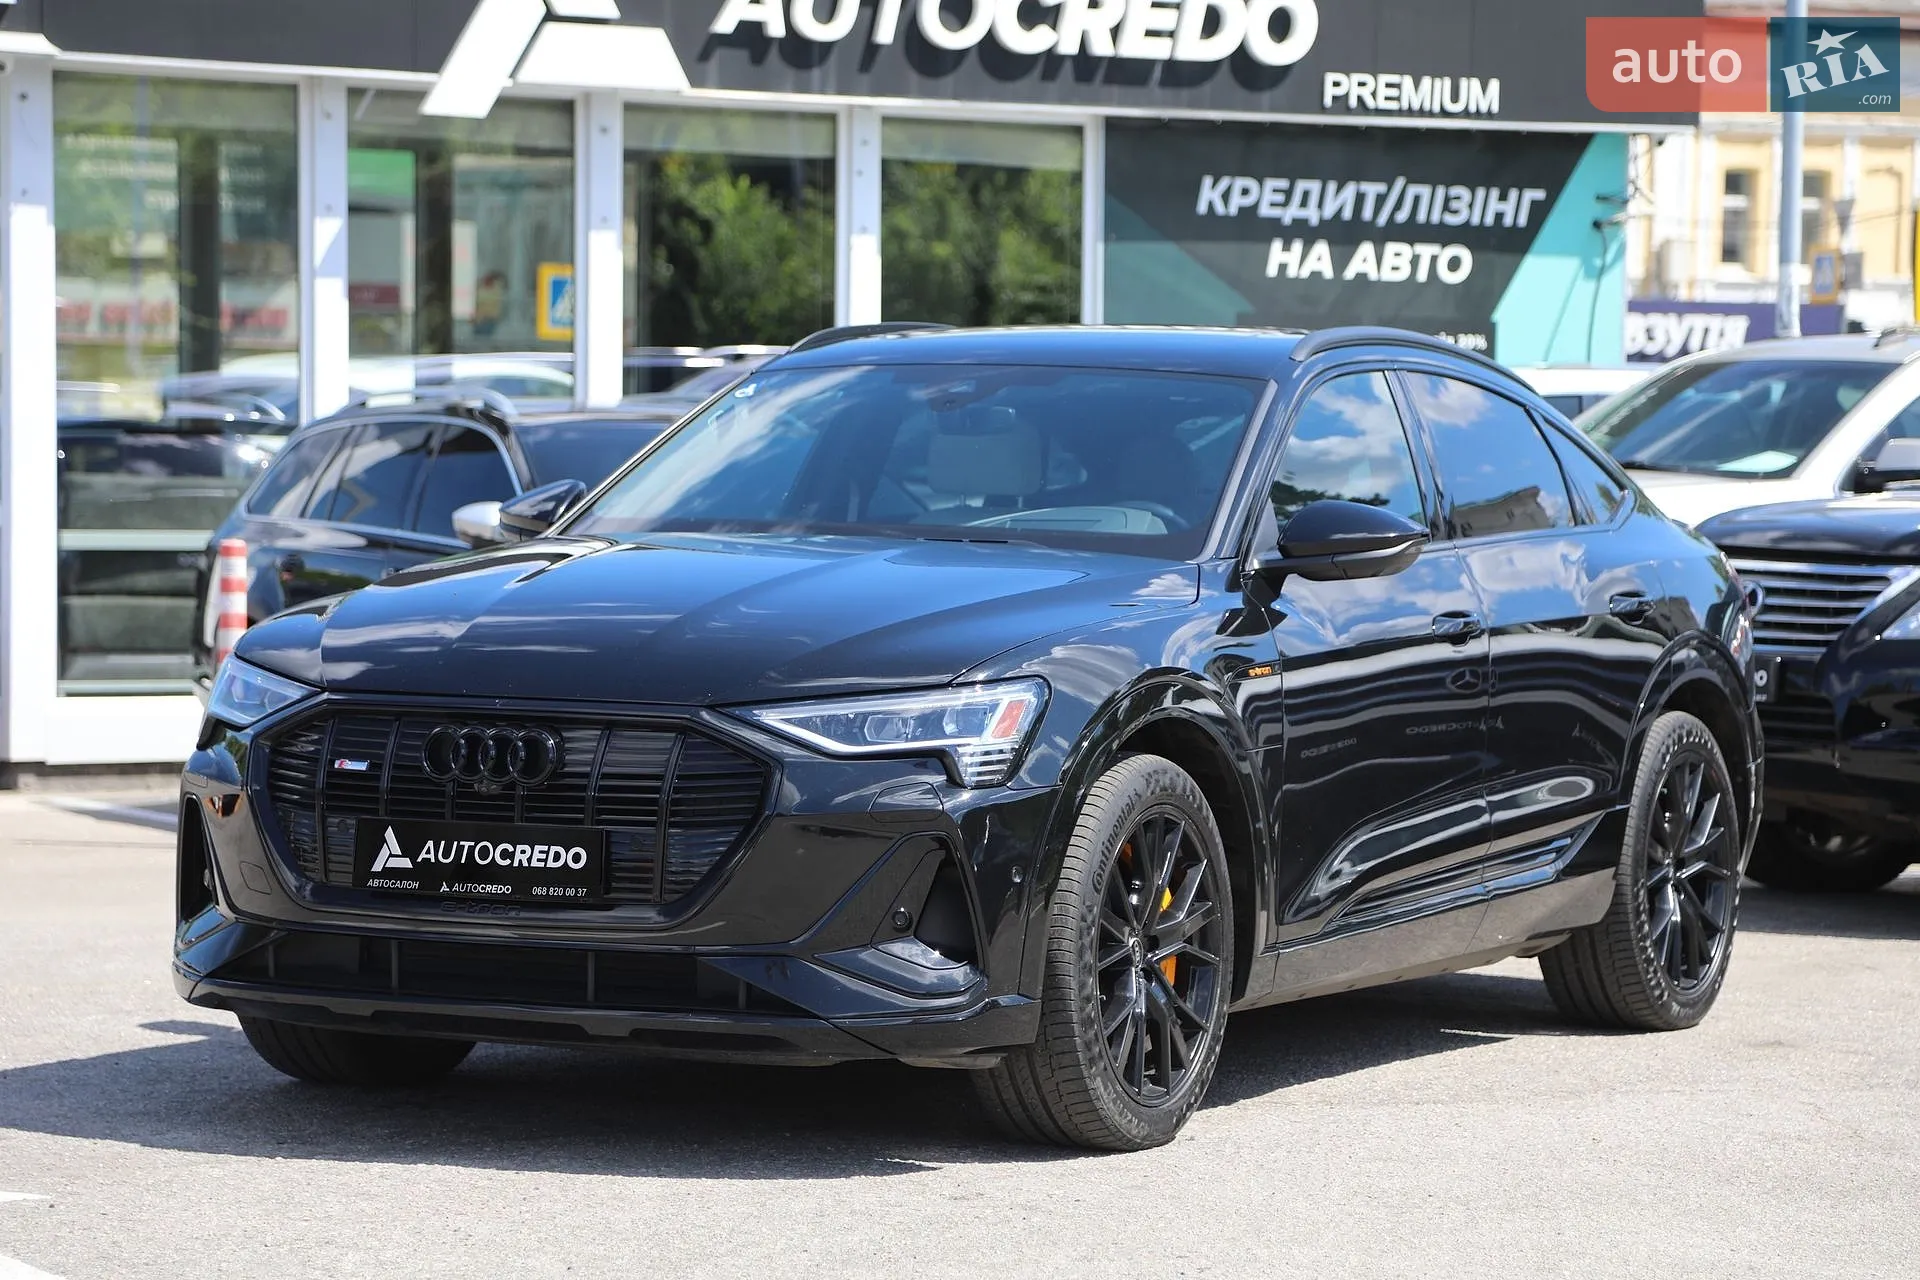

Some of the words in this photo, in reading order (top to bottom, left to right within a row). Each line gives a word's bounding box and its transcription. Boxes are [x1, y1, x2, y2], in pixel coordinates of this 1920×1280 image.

[1322, 71, 1500, 115] PREMIUM
[1195, 174, 1547, 229] КРЕДИТ/ЛІЗІНГ
[1265, 237, 1334, 280] НА
[1342, 240, 1474, 286] АВТО
[416, 839, 588, 870] AUTOCREDO
[1091, 794, 1137, 896] Continental
[366, 878, 420, 890] АВТОСАЛОН
[451, 882, 512, 894] AUTOCREDO
[532, 886, 547, 896] 068
[548, 887, 563, 896] 820
[565, 887, 575, 897] 00
[577, 888, 587, 897] 37
